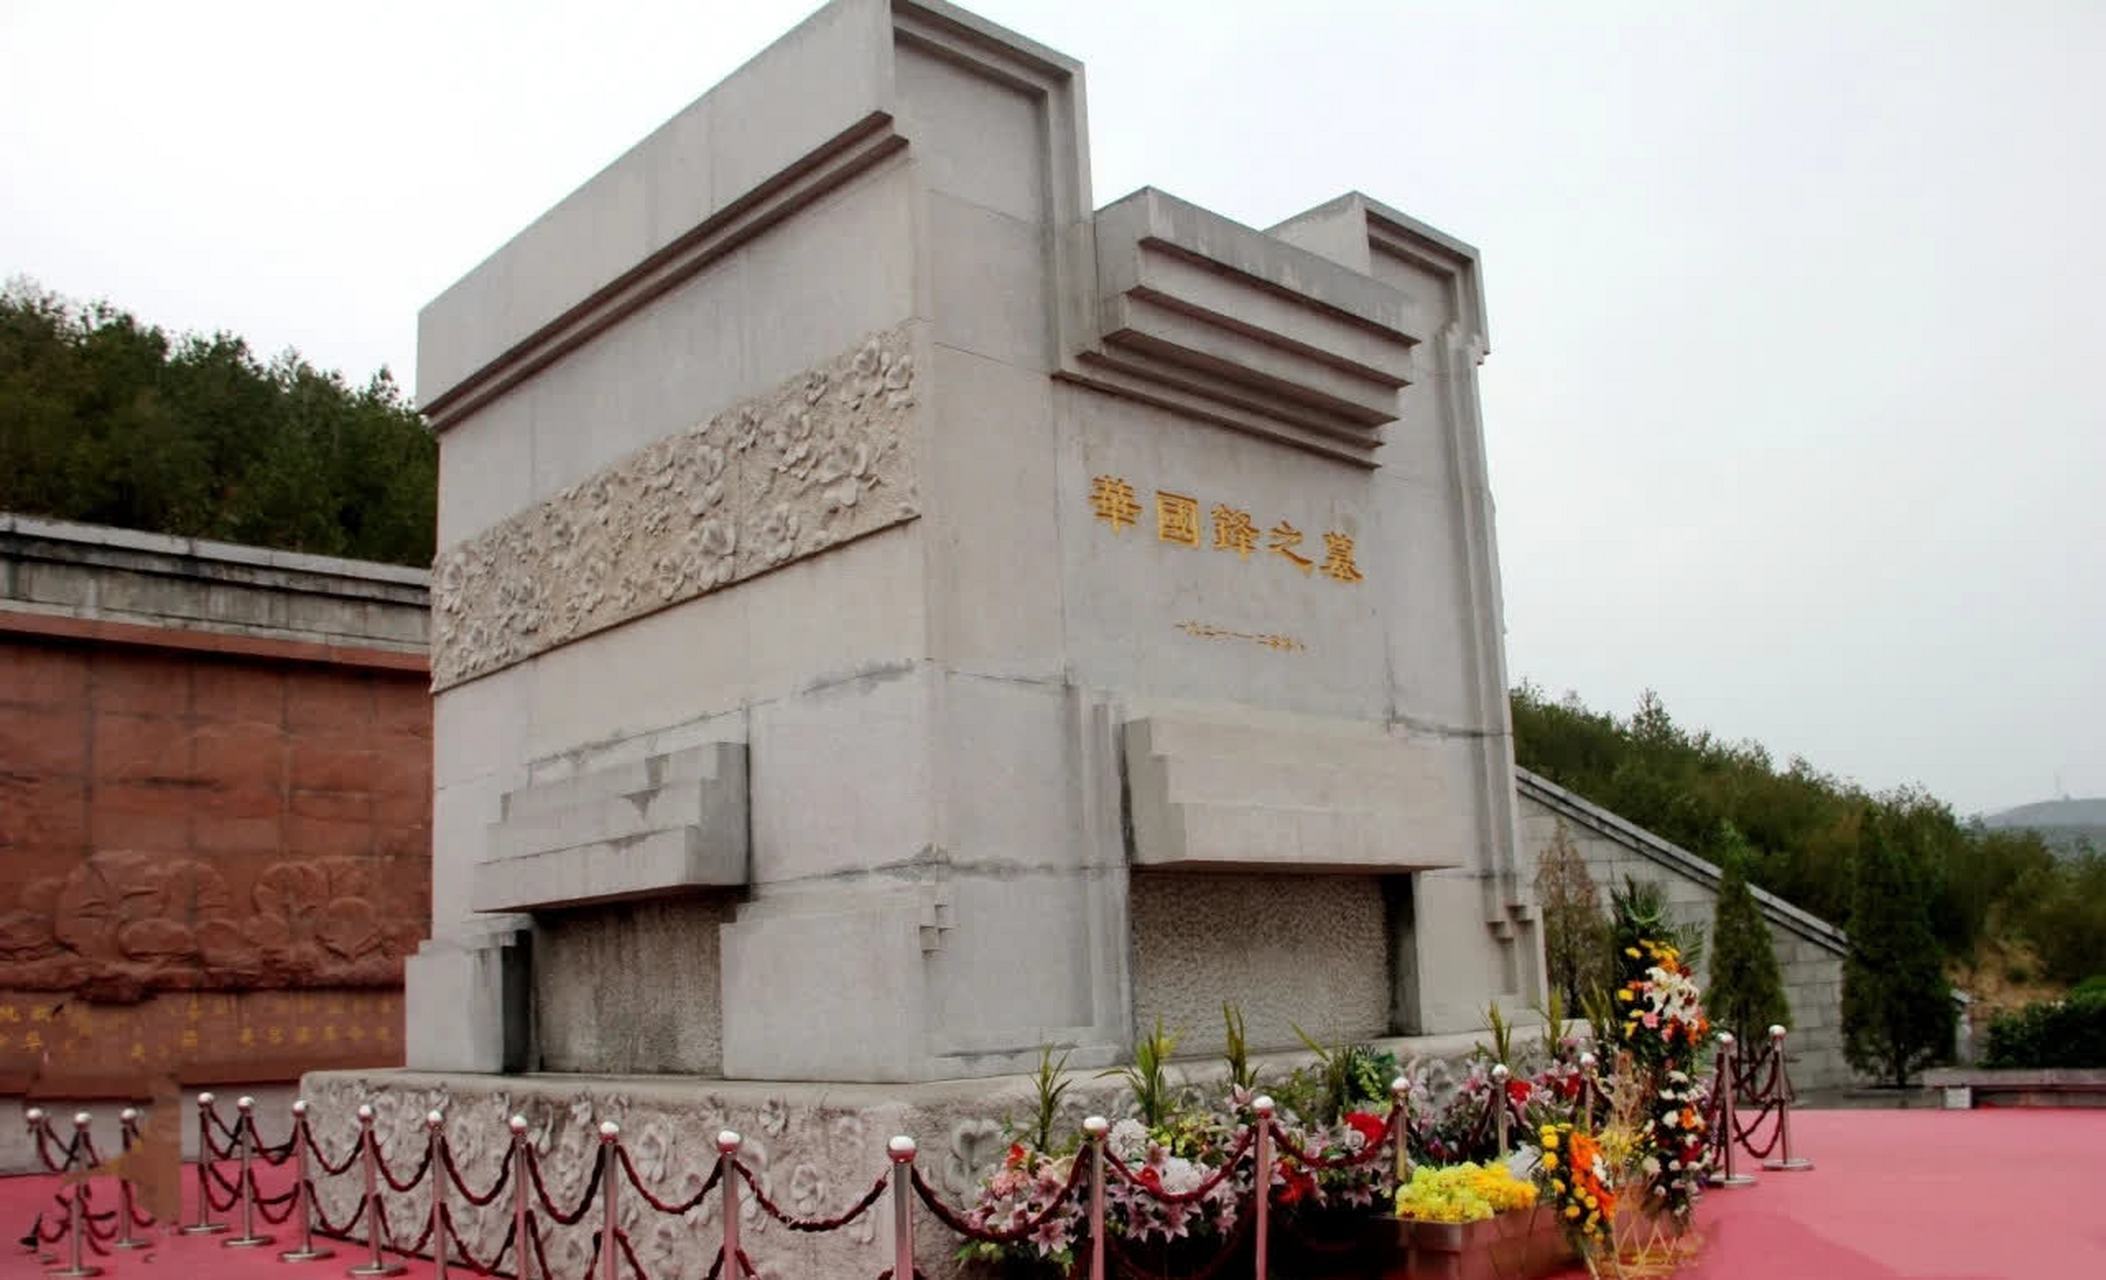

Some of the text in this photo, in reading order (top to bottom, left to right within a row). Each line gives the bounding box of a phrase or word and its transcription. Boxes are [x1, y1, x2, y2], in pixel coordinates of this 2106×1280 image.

[1089, 474, 1364, 583] 華國鋒之墓
